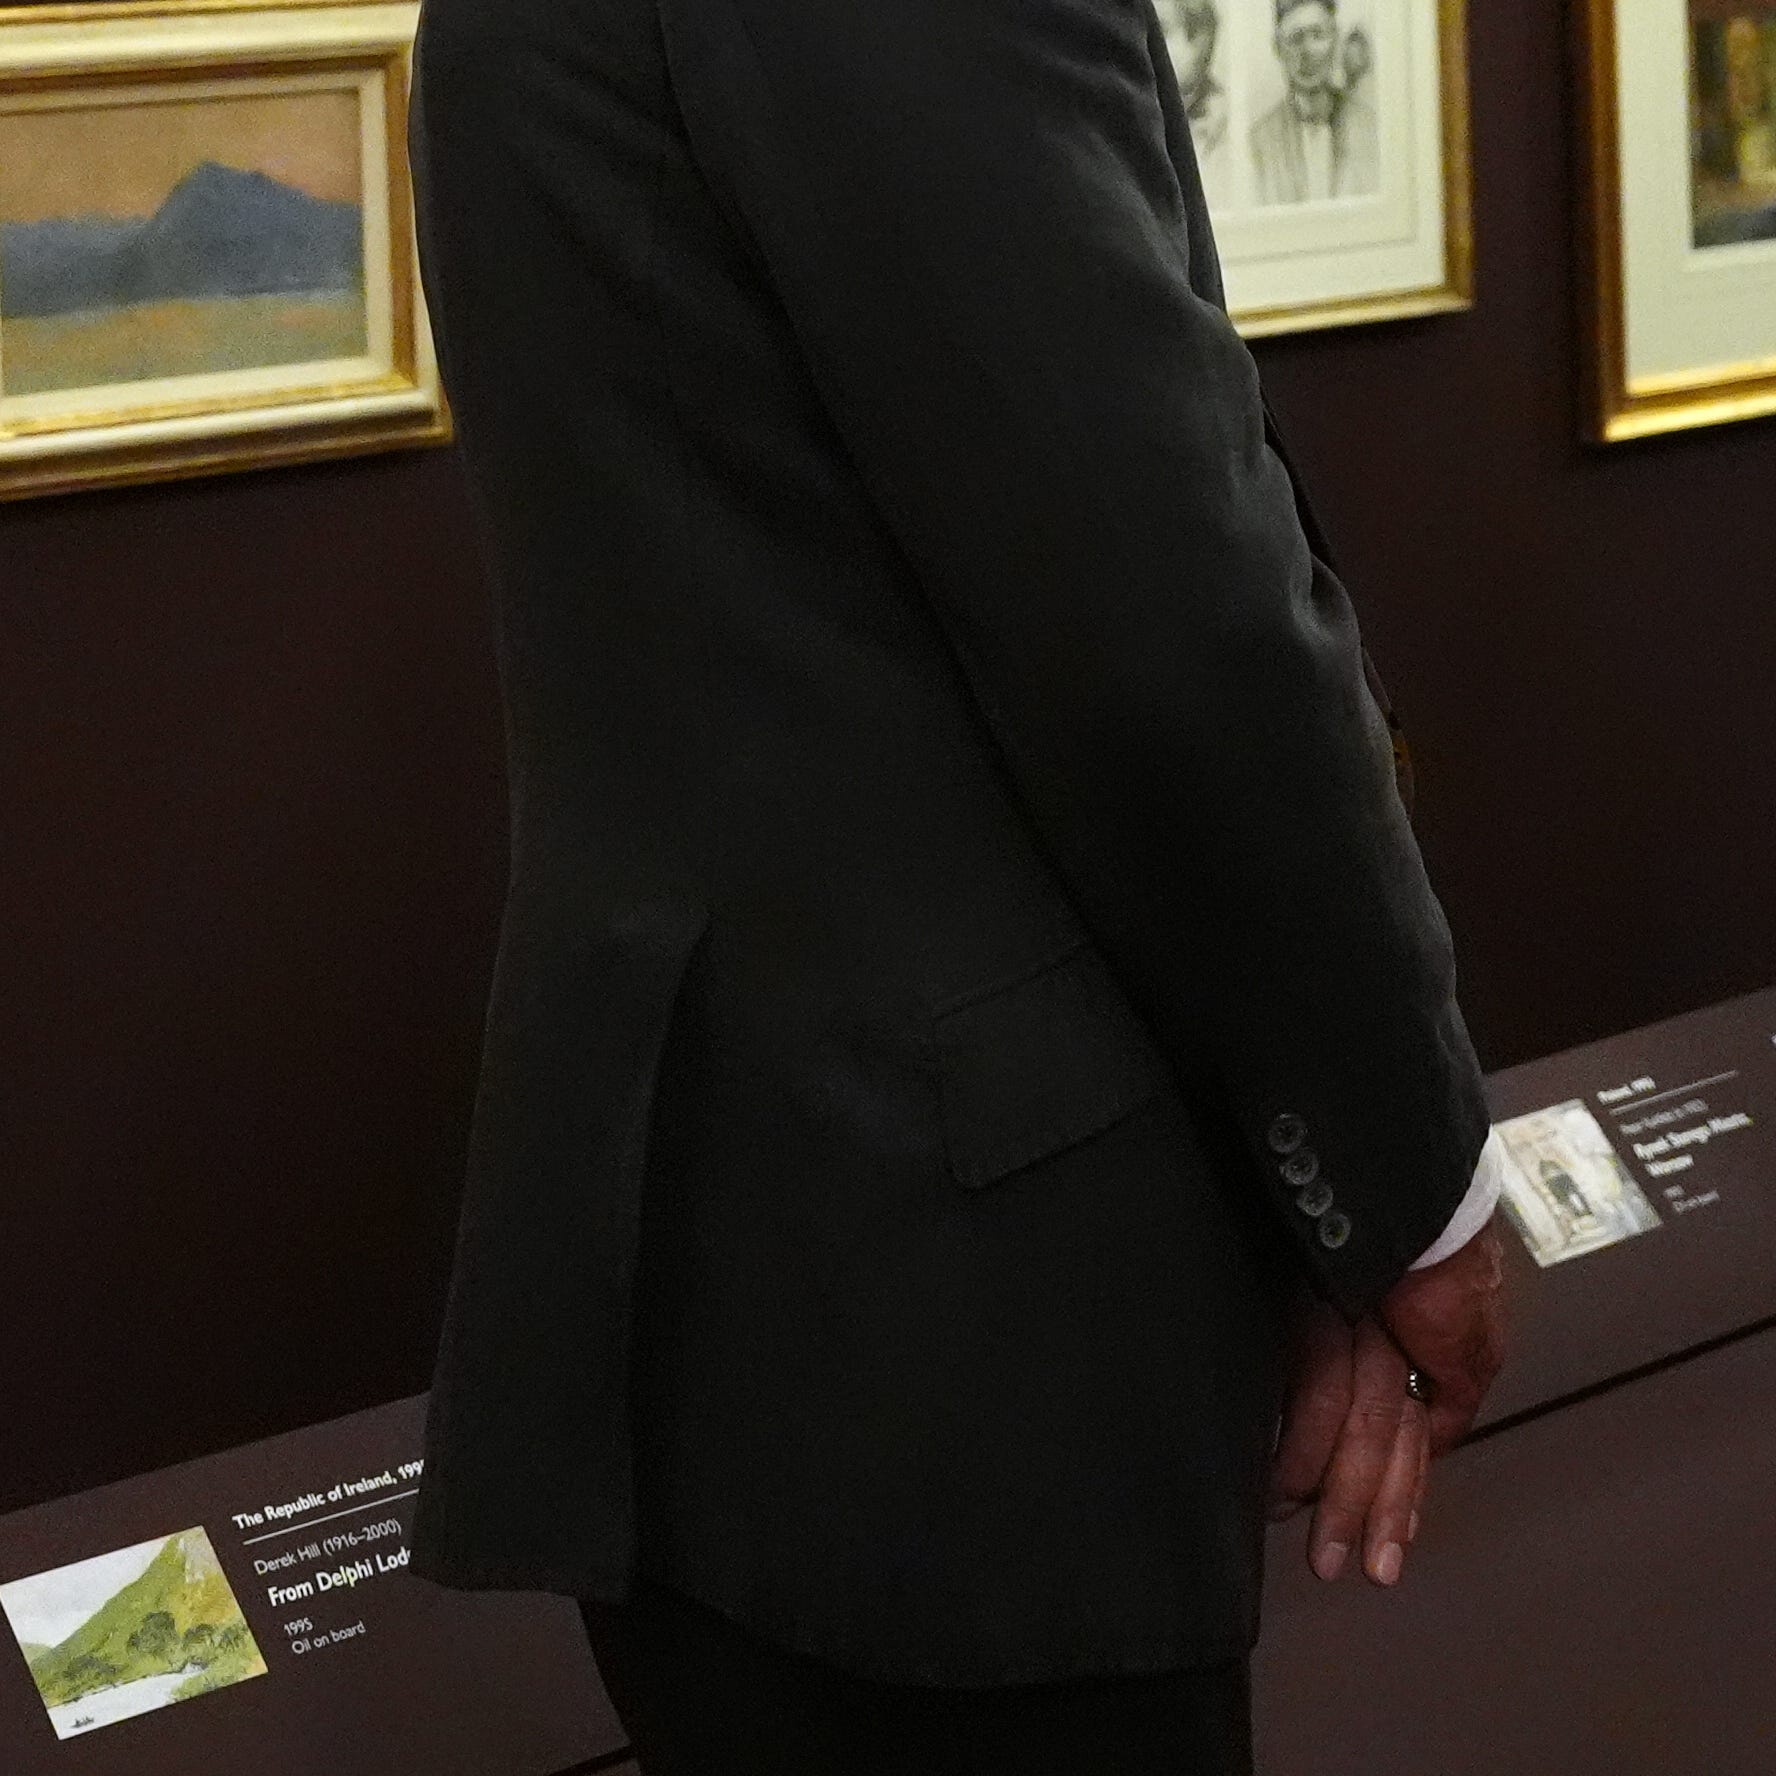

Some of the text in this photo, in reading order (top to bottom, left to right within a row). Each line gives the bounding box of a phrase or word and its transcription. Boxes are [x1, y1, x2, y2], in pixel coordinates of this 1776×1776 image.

[232, 1511, 264, 1529] The
[264, 1492, 325, 1519] Republic
[327, 1484, 343, 1502] of
[344, 1470, 397, 1497] Ireland,
[254, 1550, 296, 1575] Derek
[297, 1542, 321, 1562] Hill
[267, 1546, 411, 1607] From Delphi Lod
[284, 1617, 313, 1637] 1995
[291, 1620, 366, 1655] Oil on board
